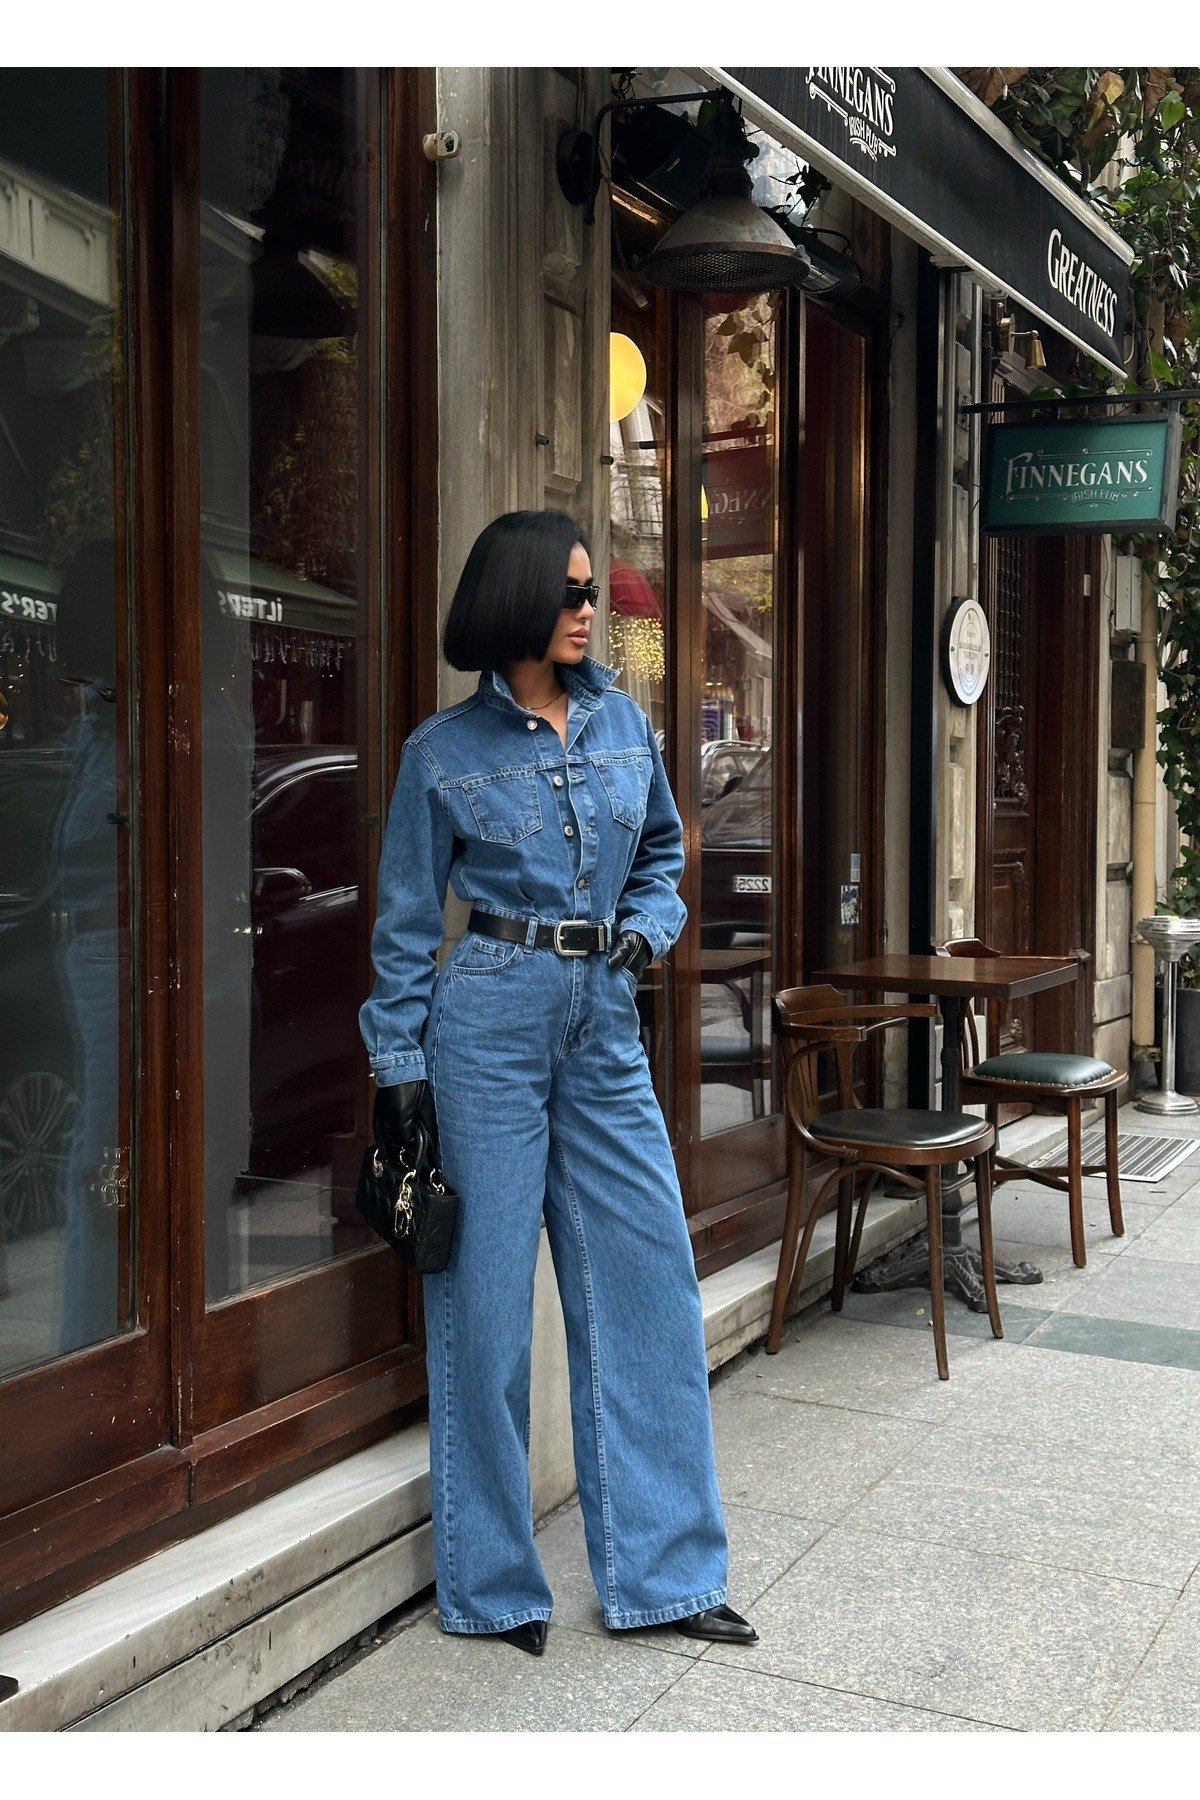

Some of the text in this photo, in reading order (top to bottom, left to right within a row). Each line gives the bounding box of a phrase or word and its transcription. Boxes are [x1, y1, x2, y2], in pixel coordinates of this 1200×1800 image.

[806, 67, 894, 137] NEGANS
[1046, 229, 1118, 338] GREATNESS
[1003, 452, 1148, 495] FINNEGANS
